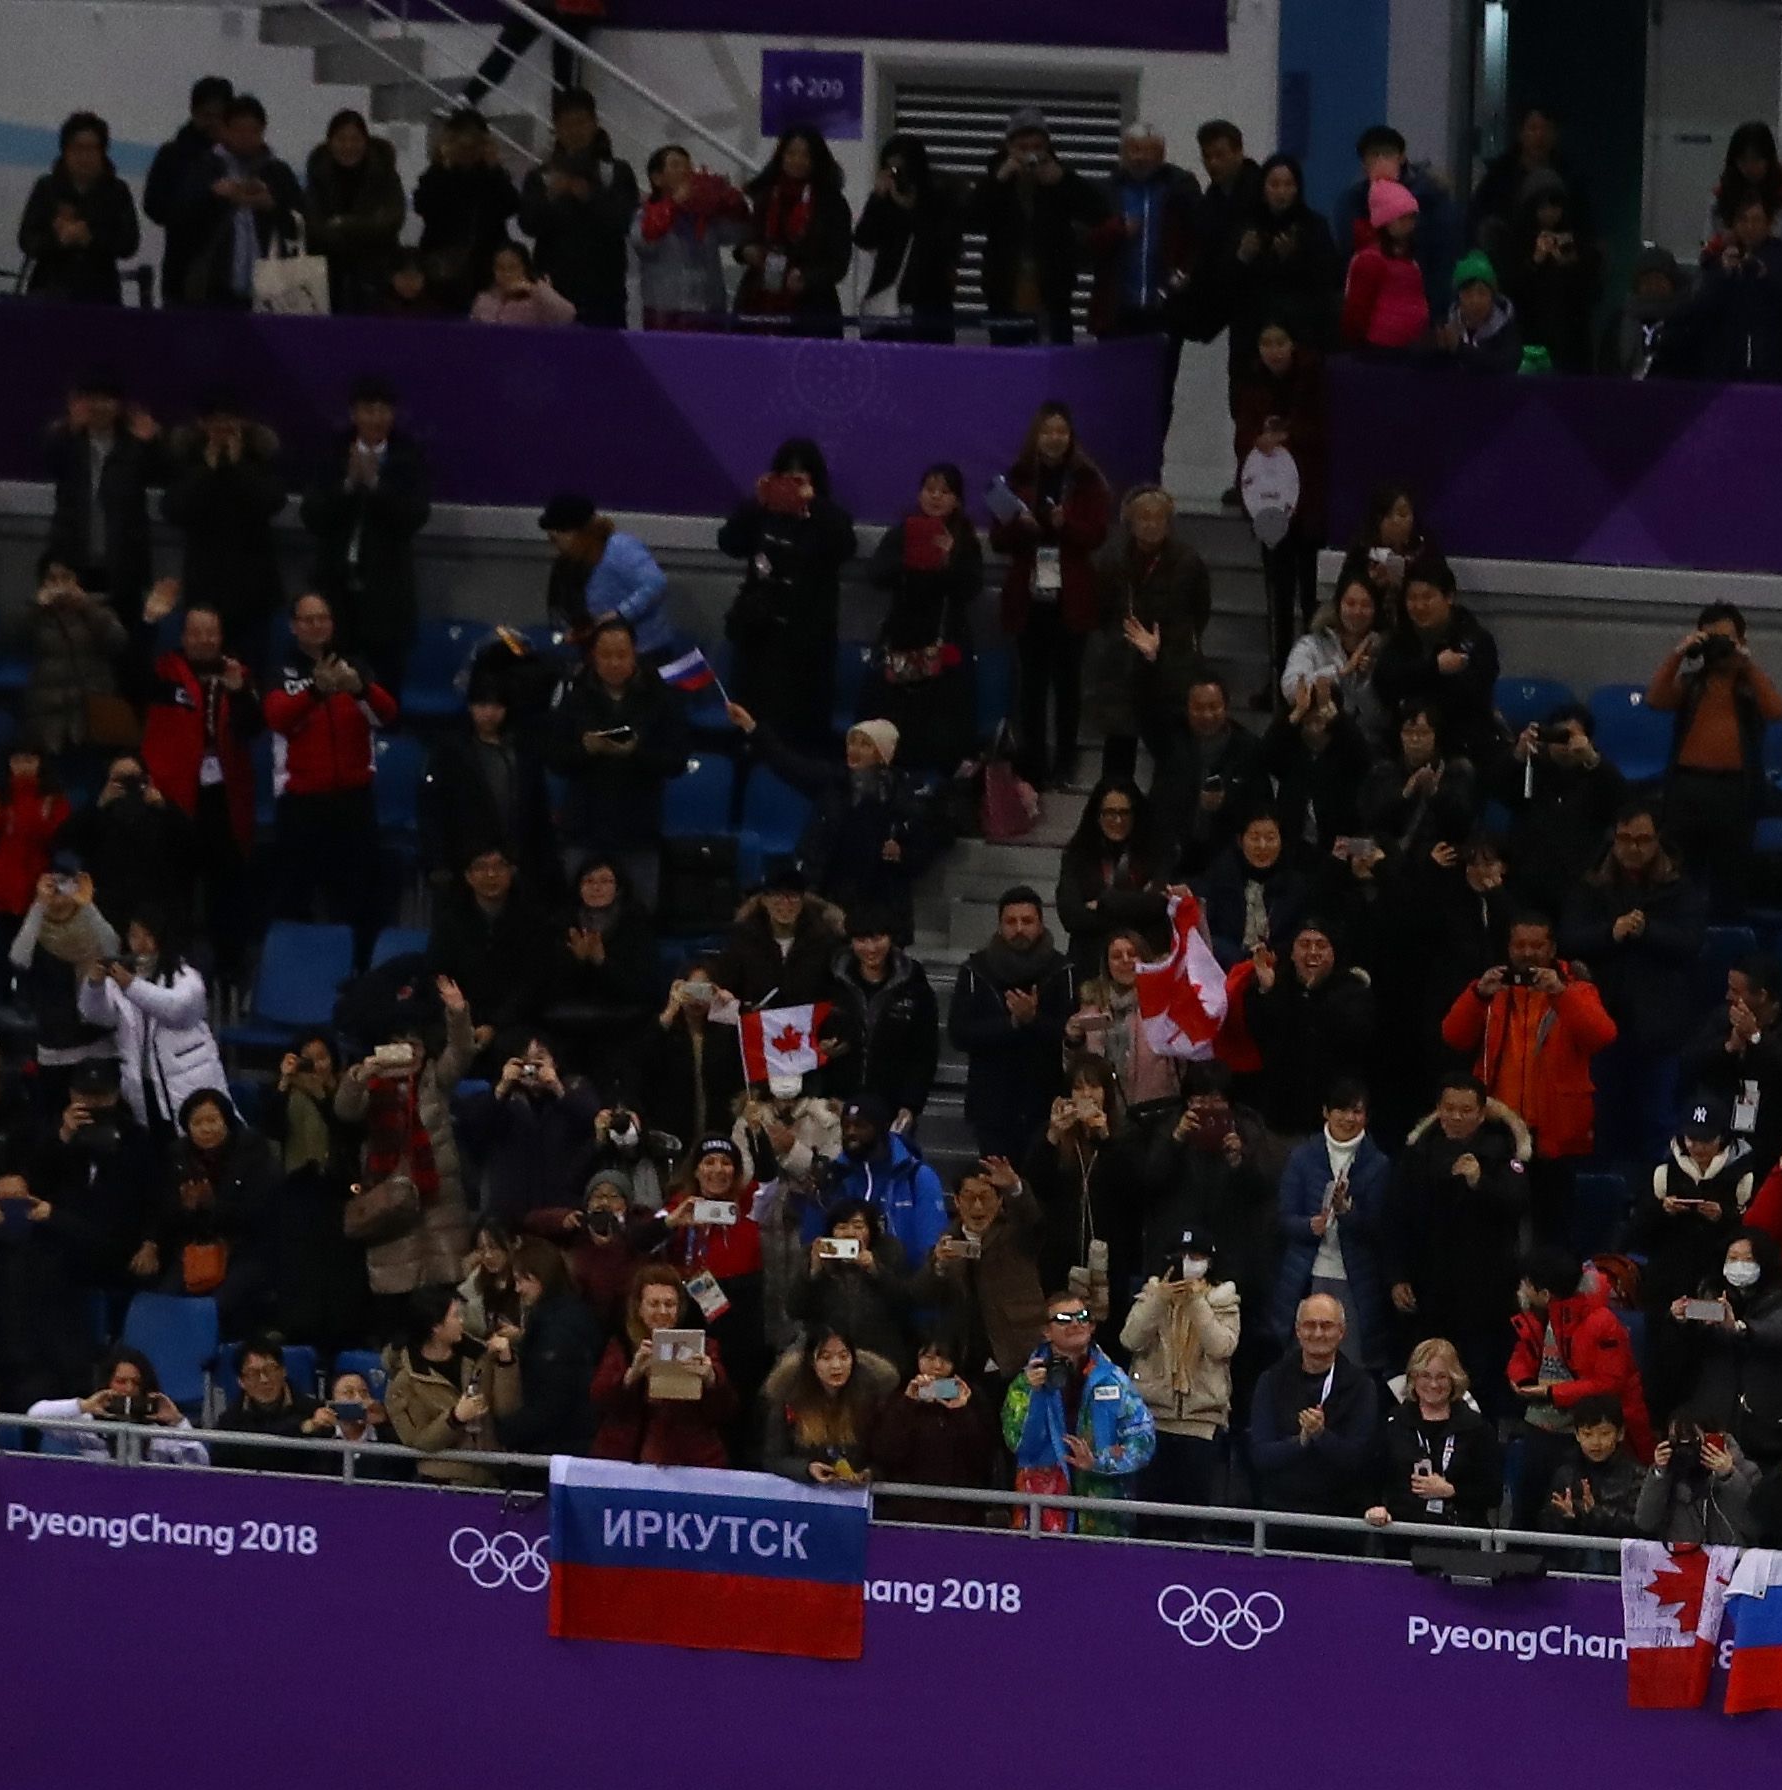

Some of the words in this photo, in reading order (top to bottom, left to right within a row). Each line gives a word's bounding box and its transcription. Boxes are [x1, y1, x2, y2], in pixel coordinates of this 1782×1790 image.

[7, 1503, 235, 1556] PyeongChang
[240, 1520, 318, 1555] 2018
[603, 1508, 809, 1560] ИРКУТСК
[940, 1578, 1021, 1614] 2018
[1408, 1614, 1628, 1661] PyeongChan
